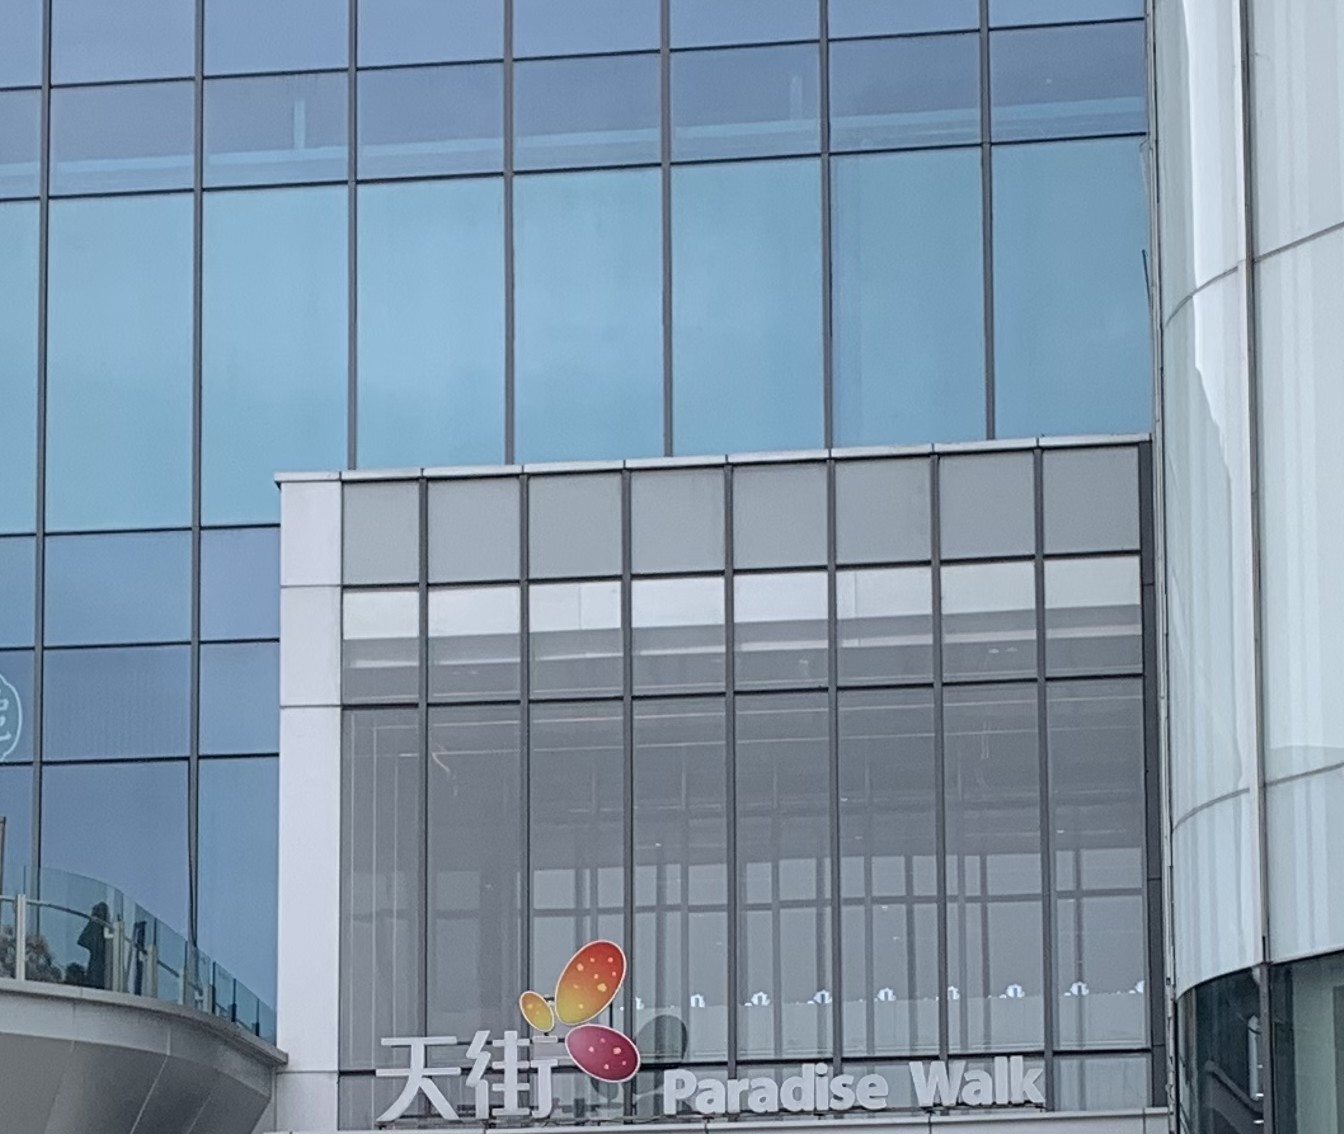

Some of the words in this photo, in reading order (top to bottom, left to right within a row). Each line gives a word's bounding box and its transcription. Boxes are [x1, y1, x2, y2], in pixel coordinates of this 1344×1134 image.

[375, 1029, 560, 1124] 天街
[662, 1062, 889, 1116] Paradise
[909, 1055, 1046, 1108] Walk
